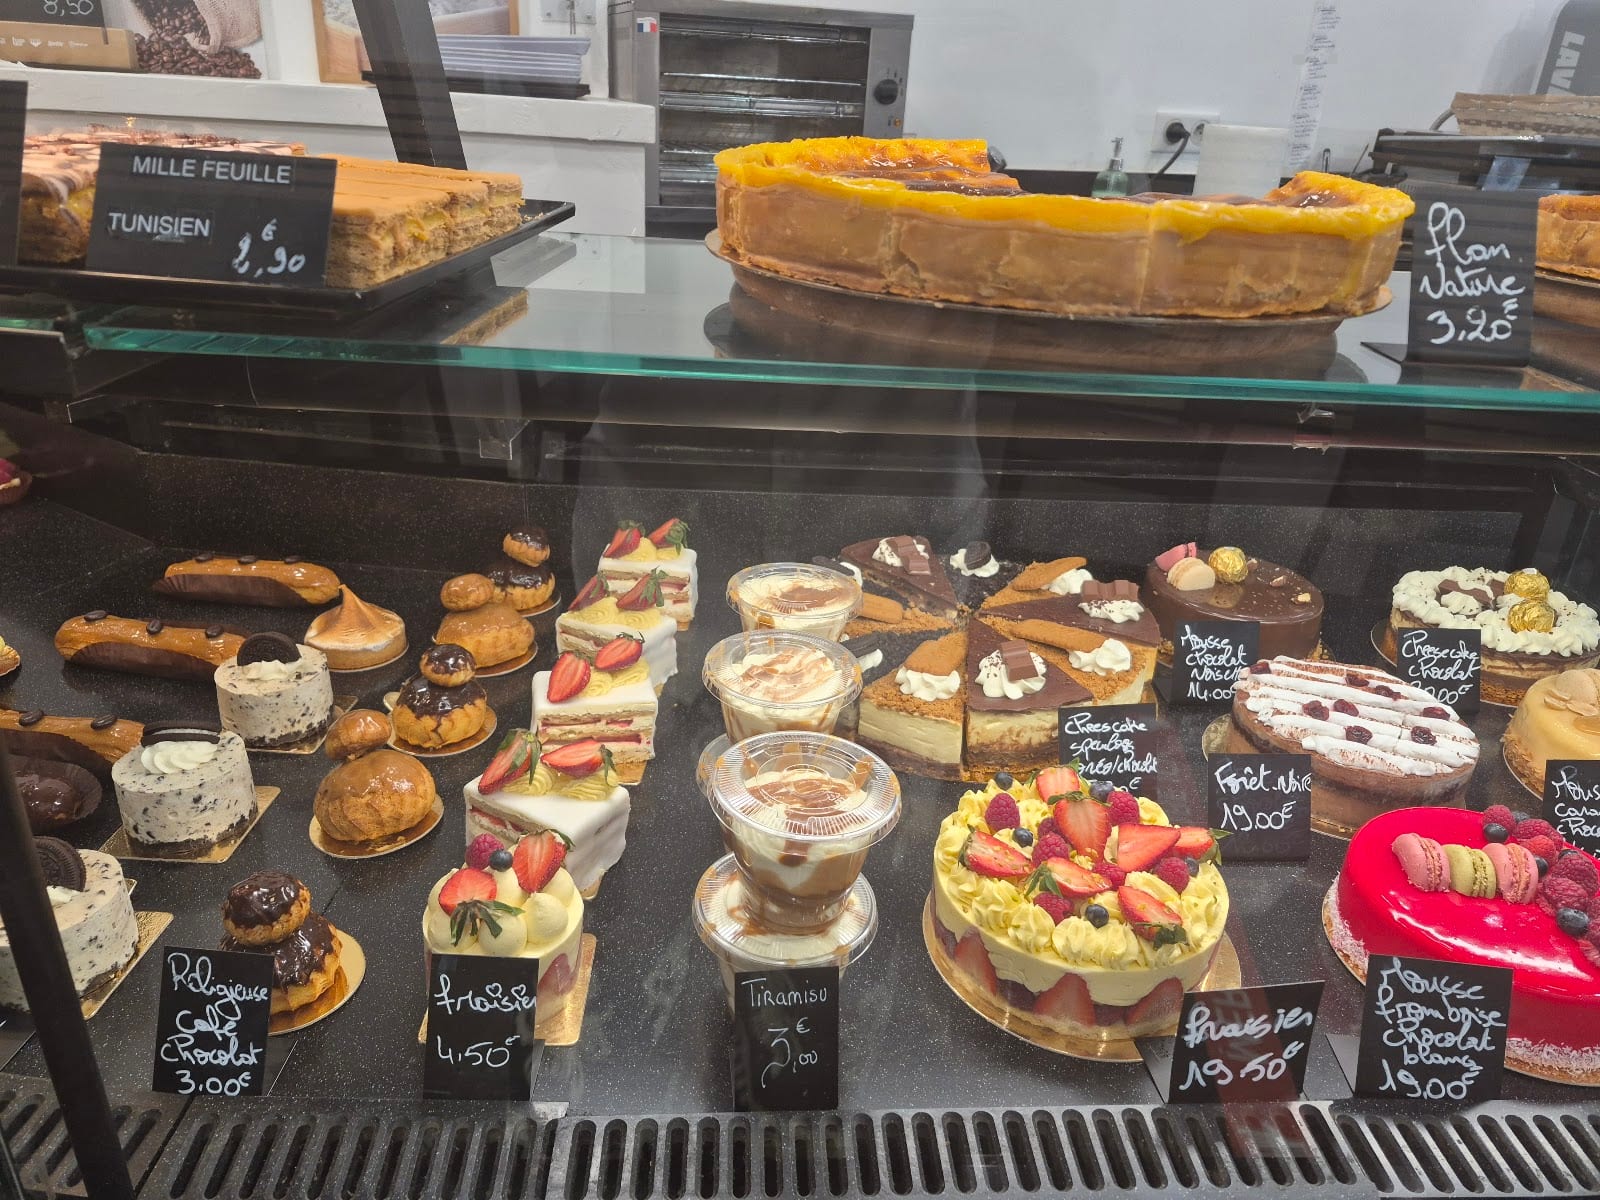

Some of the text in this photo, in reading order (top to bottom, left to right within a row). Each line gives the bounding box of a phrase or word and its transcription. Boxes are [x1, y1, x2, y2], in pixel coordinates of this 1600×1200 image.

[132, 155, 292, 184] MILLE FEUILLE
[109, 212, 211, 237] TUNISIEN
